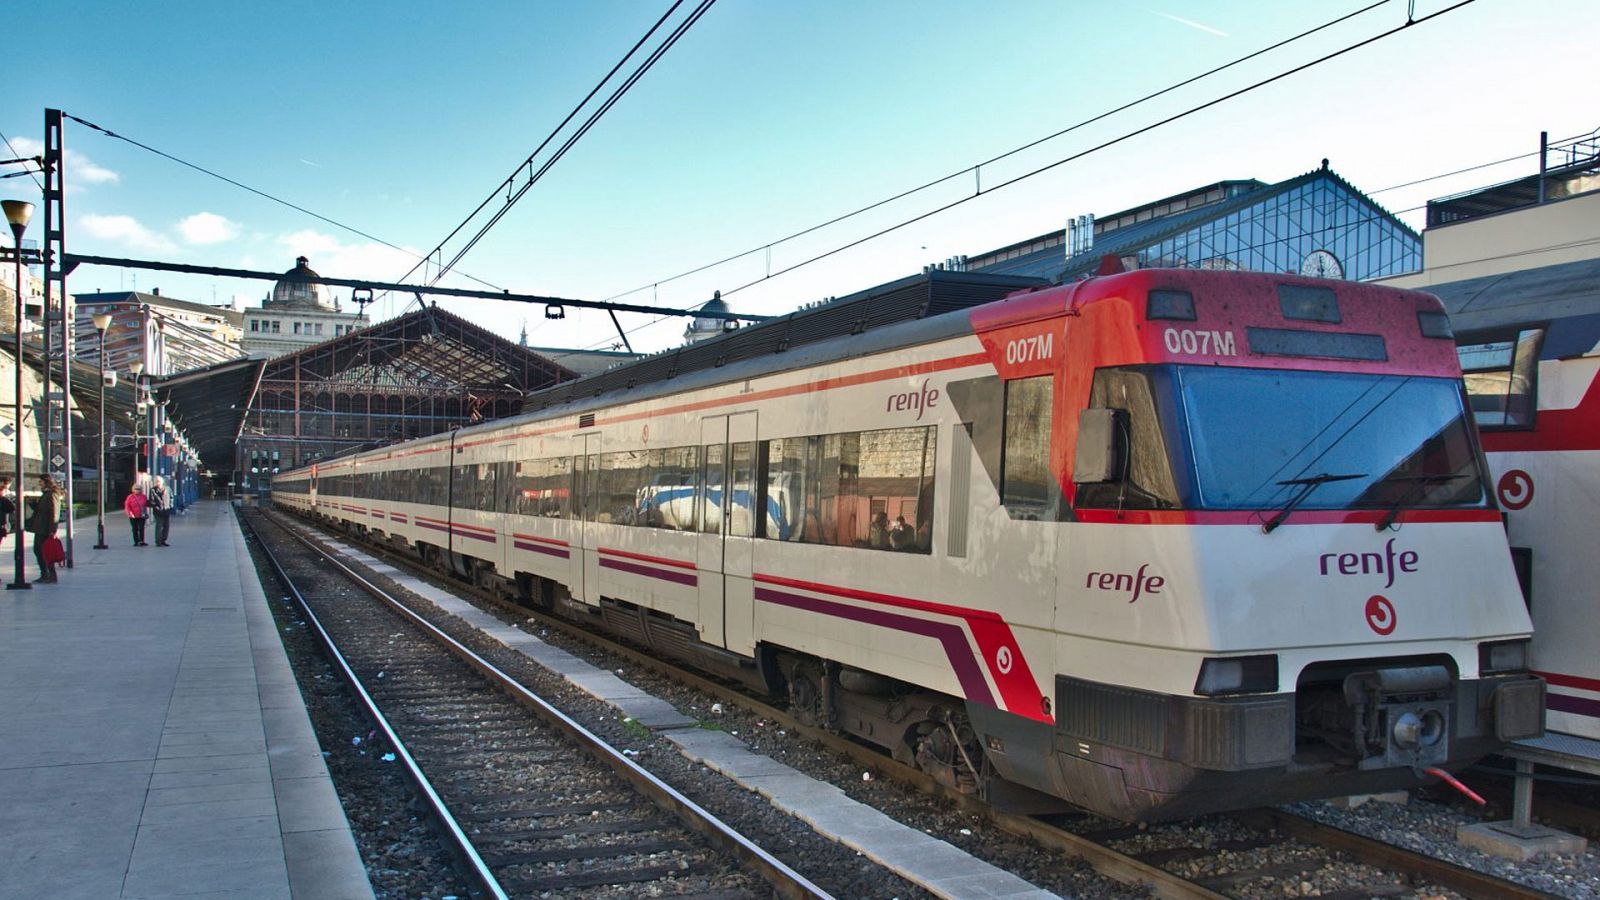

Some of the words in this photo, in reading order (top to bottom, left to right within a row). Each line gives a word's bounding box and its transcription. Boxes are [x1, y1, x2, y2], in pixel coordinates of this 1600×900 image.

[1006, 333, 1054, 365] 007M
[1164, 328, 1236, 356] 007M
[887, 378, 939, 421] renfe
[1086, 563, 1165, 604] renfe
[1320, 538, 1419, 589] renfe
